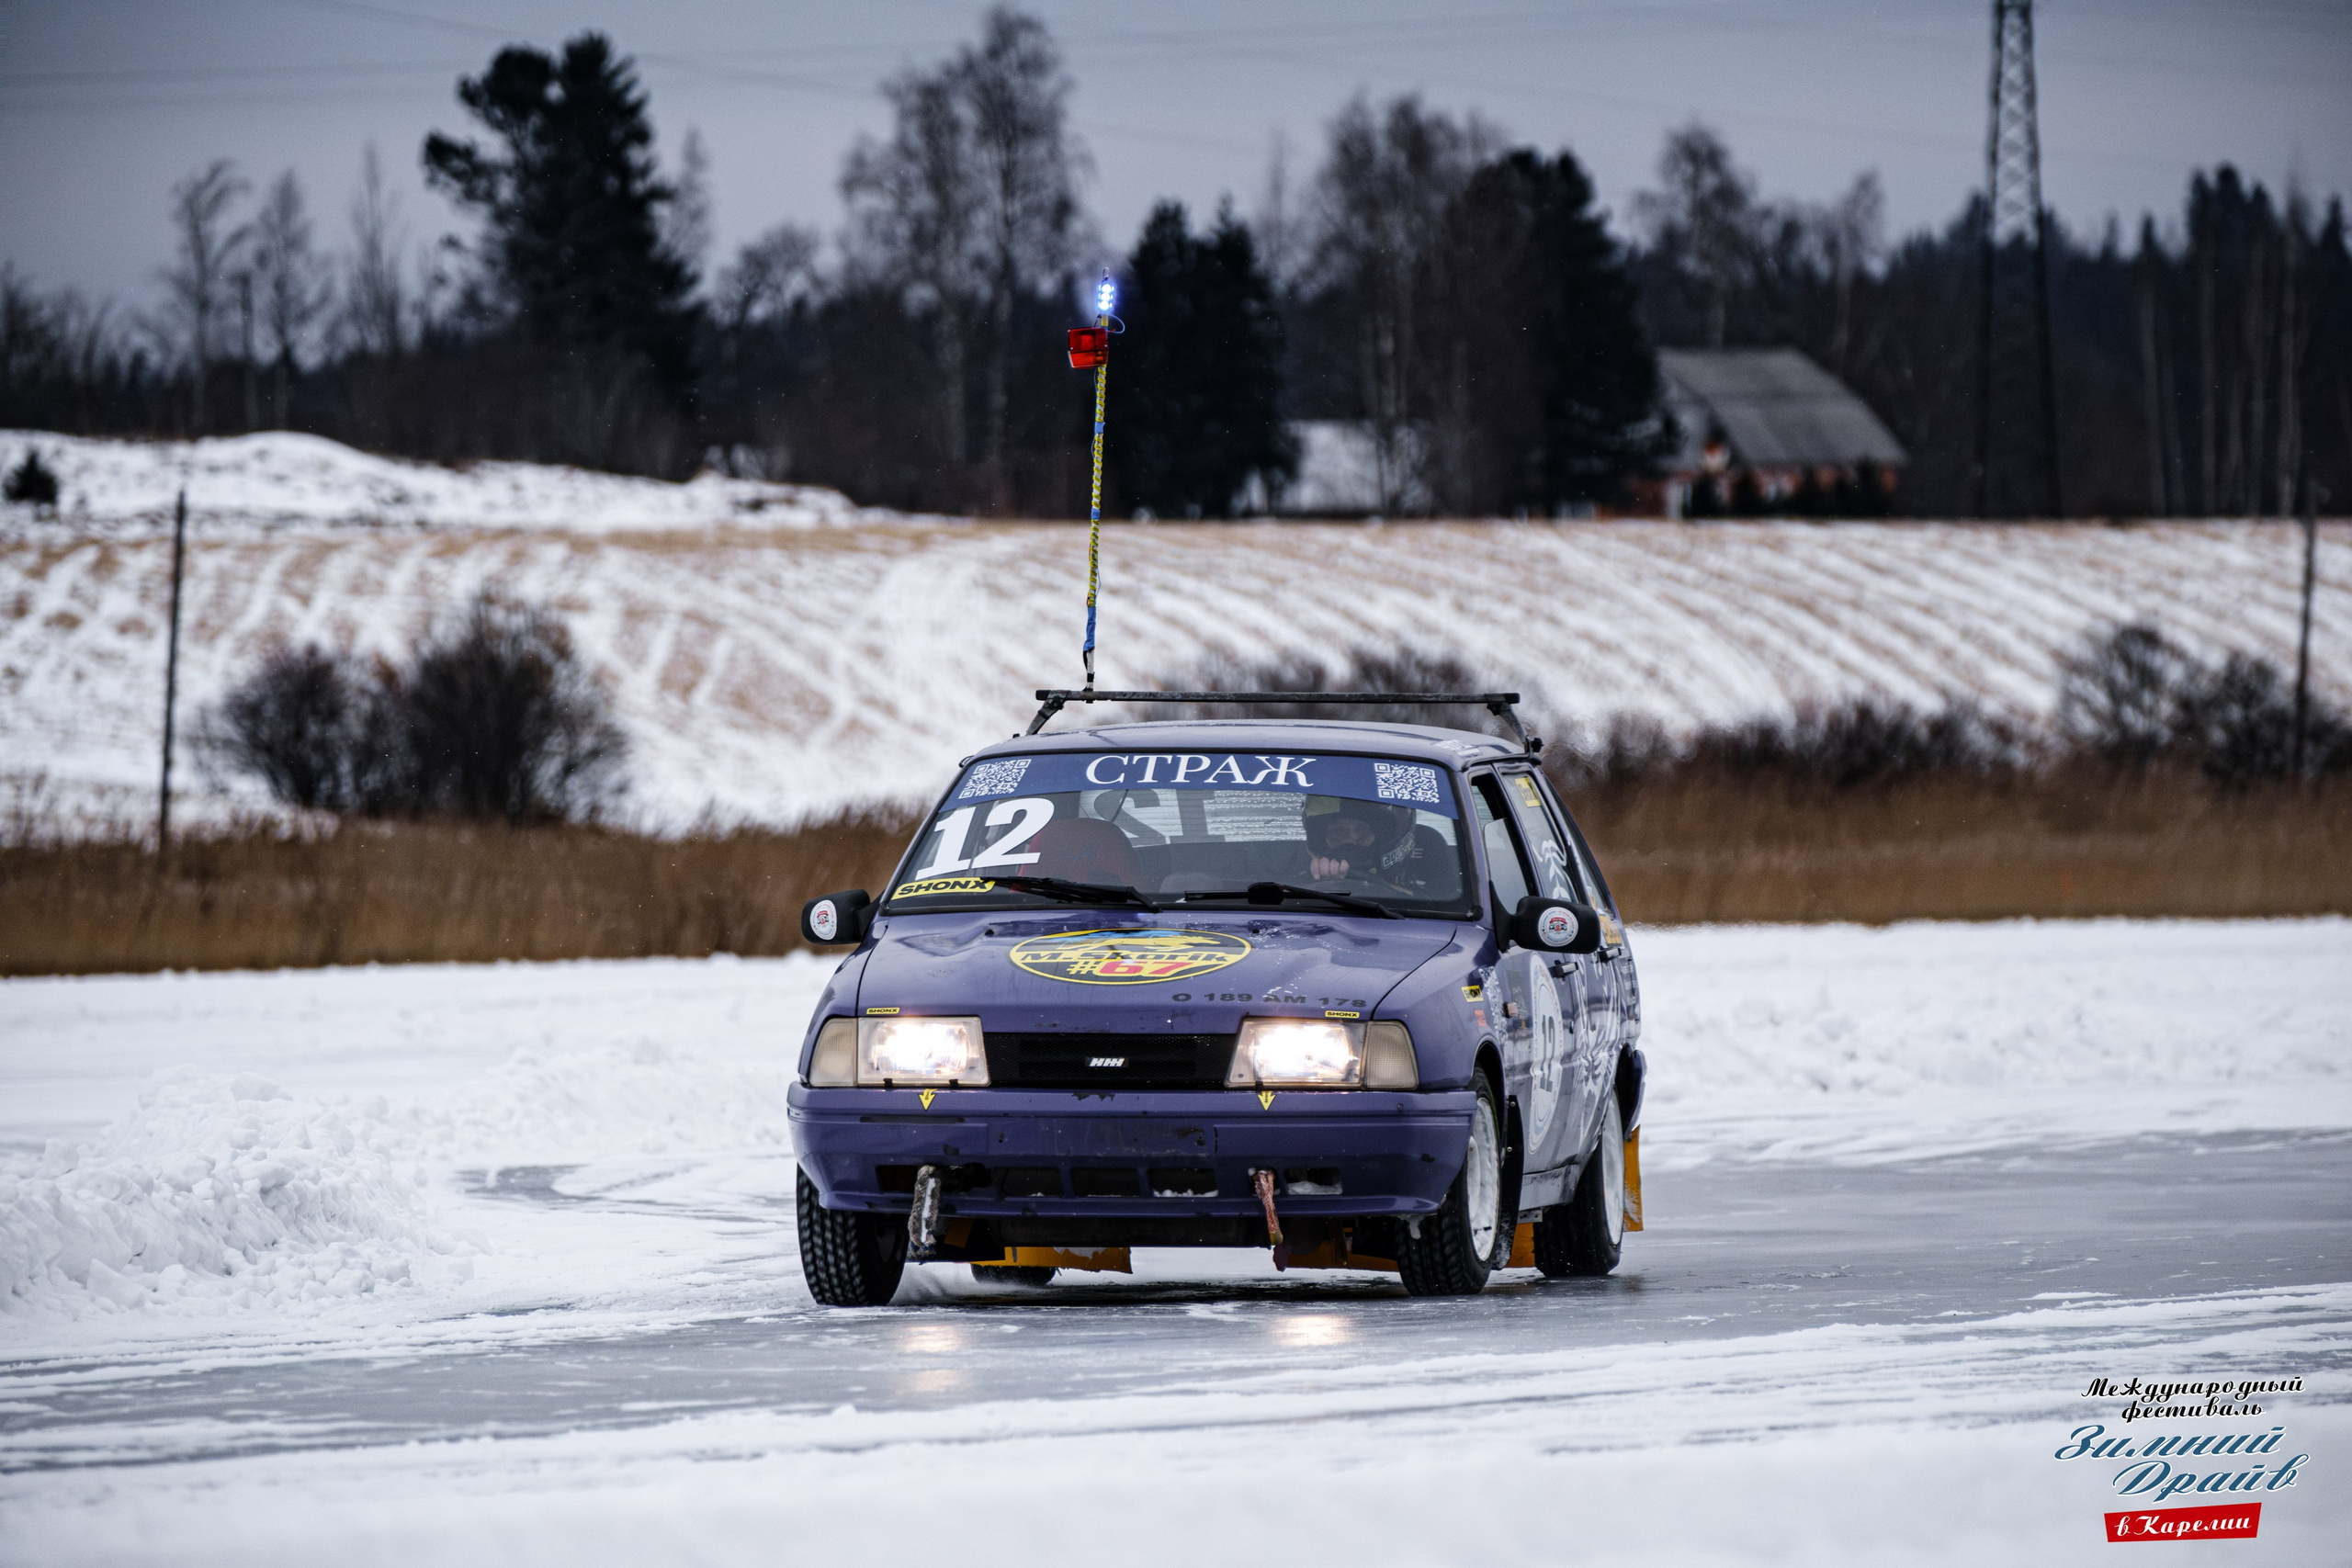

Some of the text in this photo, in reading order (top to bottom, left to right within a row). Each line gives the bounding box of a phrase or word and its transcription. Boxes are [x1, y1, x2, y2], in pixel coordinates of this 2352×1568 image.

[1086, 755, 1317, 787] СТРАЖ
[915, 797, 1055, 881] 12
[898, 880, 989, 896] SHONX
[1204, 992, 1253, 1003] 189
[1318, 997, 1367, 1008] 178
